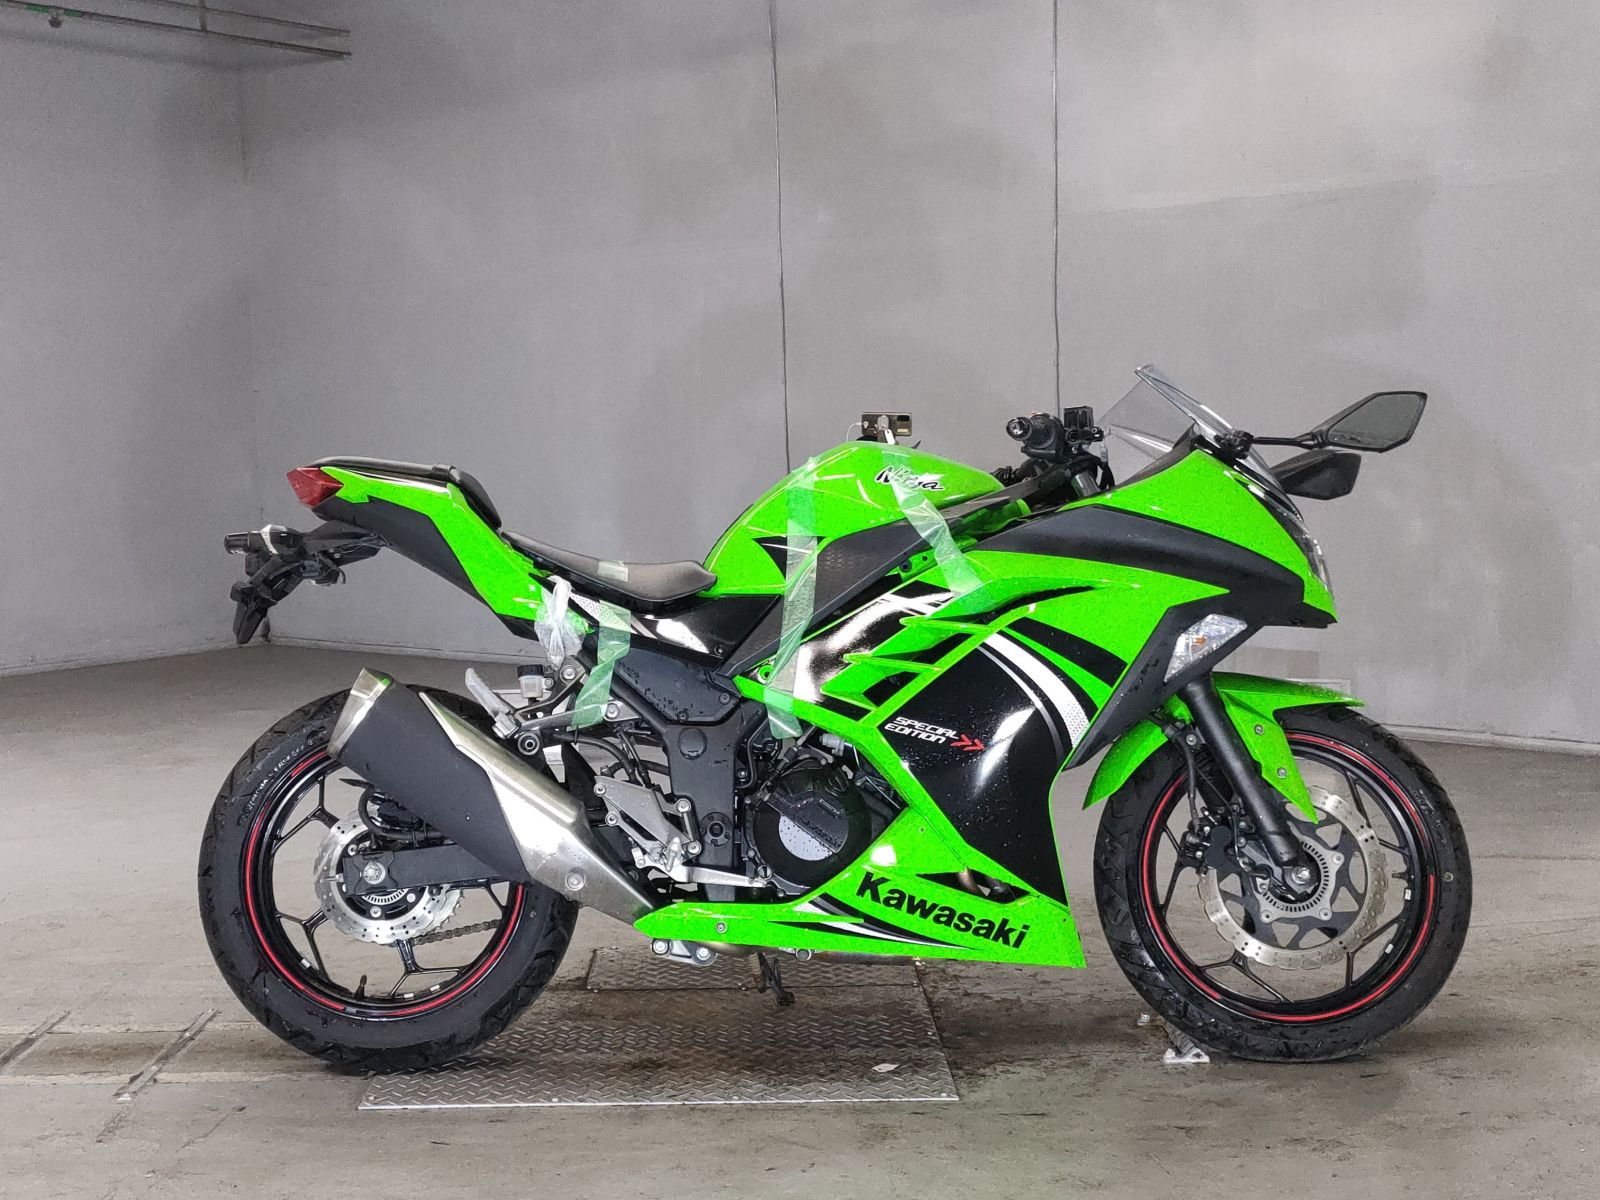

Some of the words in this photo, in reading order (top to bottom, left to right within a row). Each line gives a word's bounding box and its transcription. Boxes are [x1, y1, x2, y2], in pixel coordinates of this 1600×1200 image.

[884, 722, 946, 744] EDITION
[893, 716, 960, 740] SPECIAL
[856, 871, 1031, 949] Kawasaki
